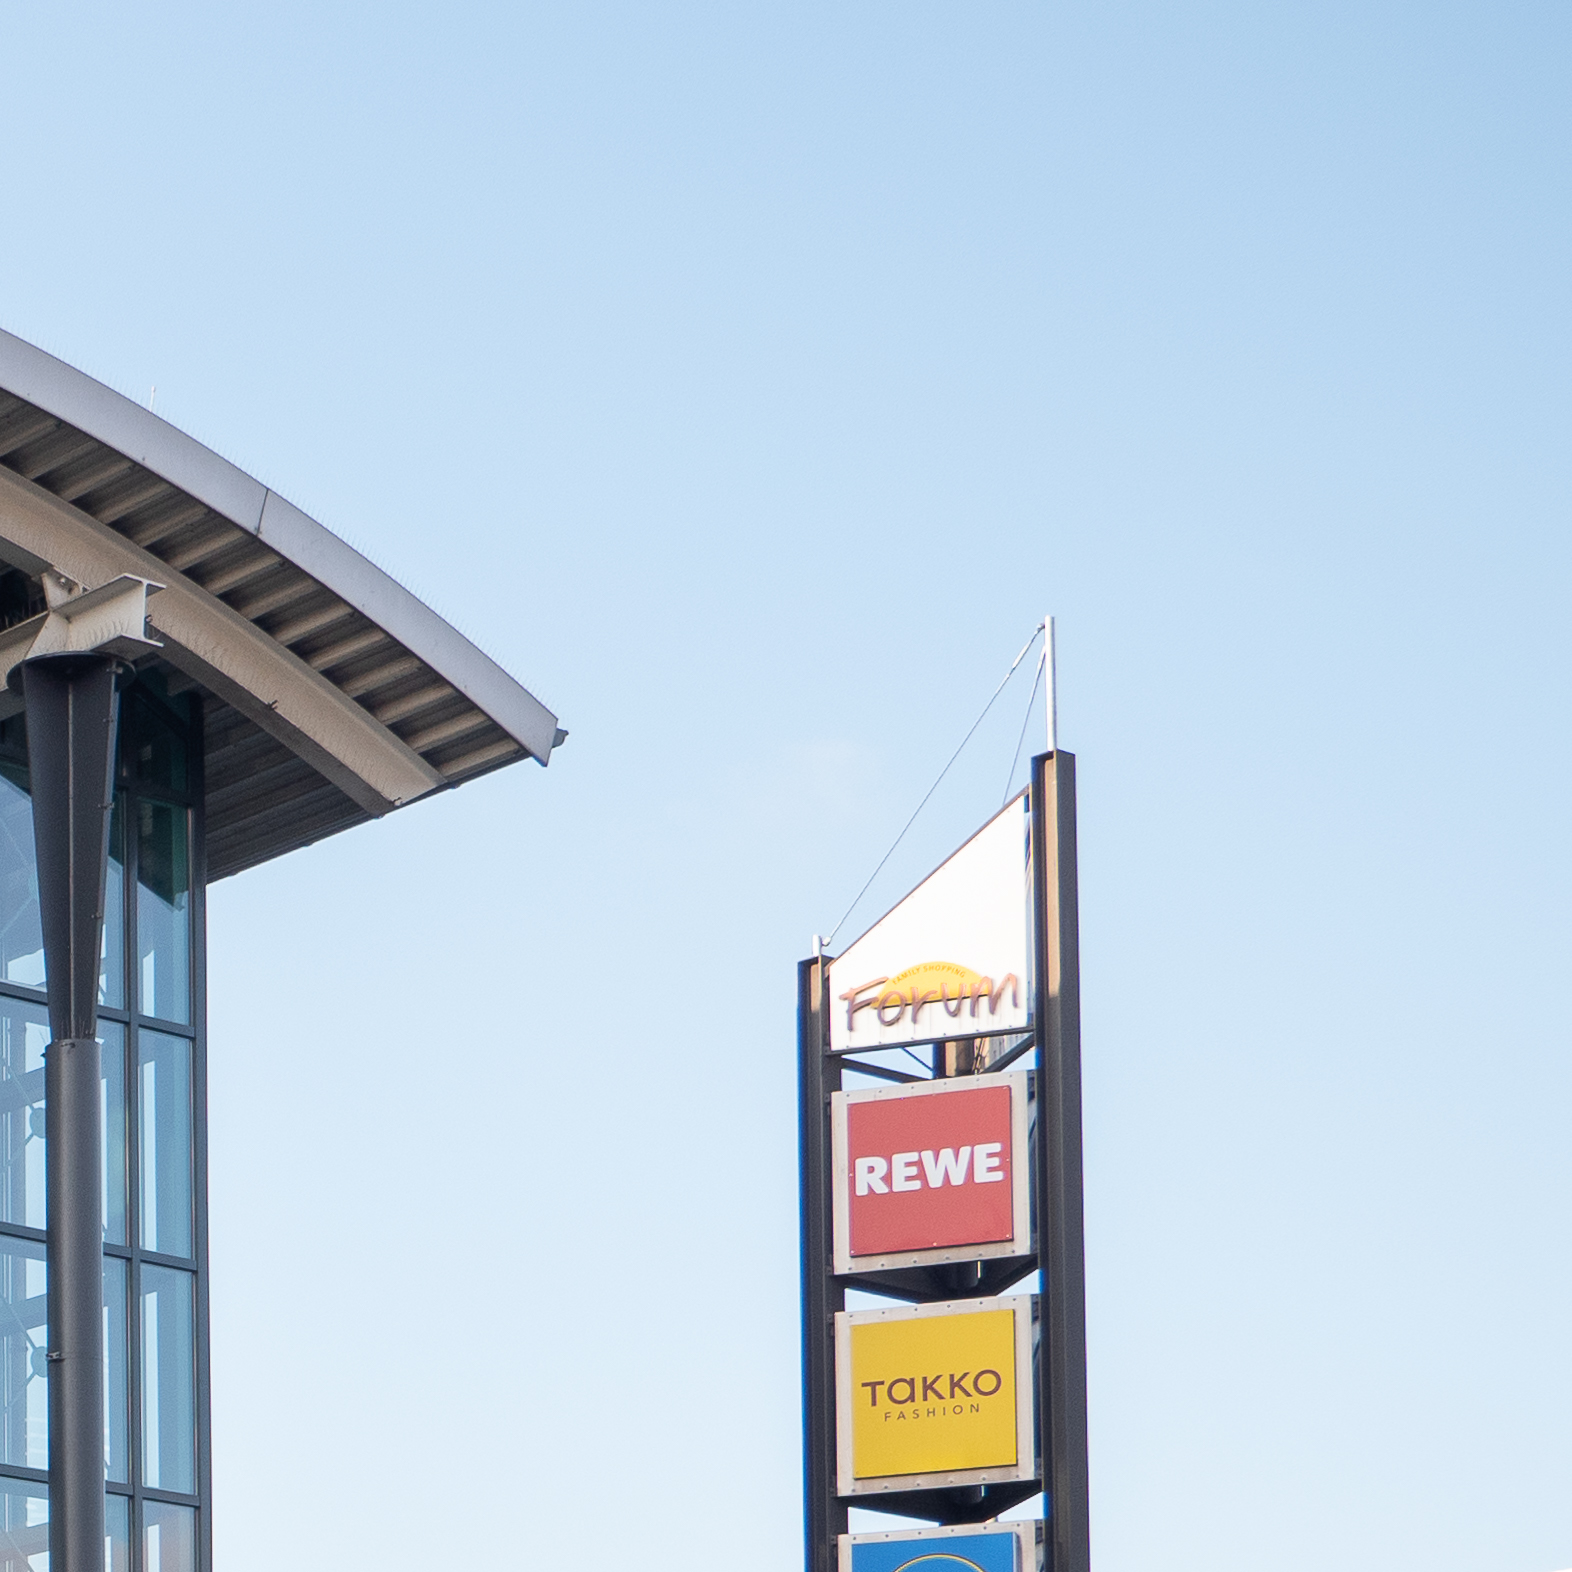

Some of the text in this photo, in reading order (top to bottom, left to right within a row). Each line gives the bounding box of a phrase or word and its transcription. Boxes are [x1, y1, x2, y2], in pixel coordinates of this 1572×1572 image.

[892, 964, 967, 986] FAMILY SHOPPING
[839, 972, 1019, 1032] Forum
[854, 1142, 1005, 1197] REWE
[884, 1403, 981, 1423] FASHION
